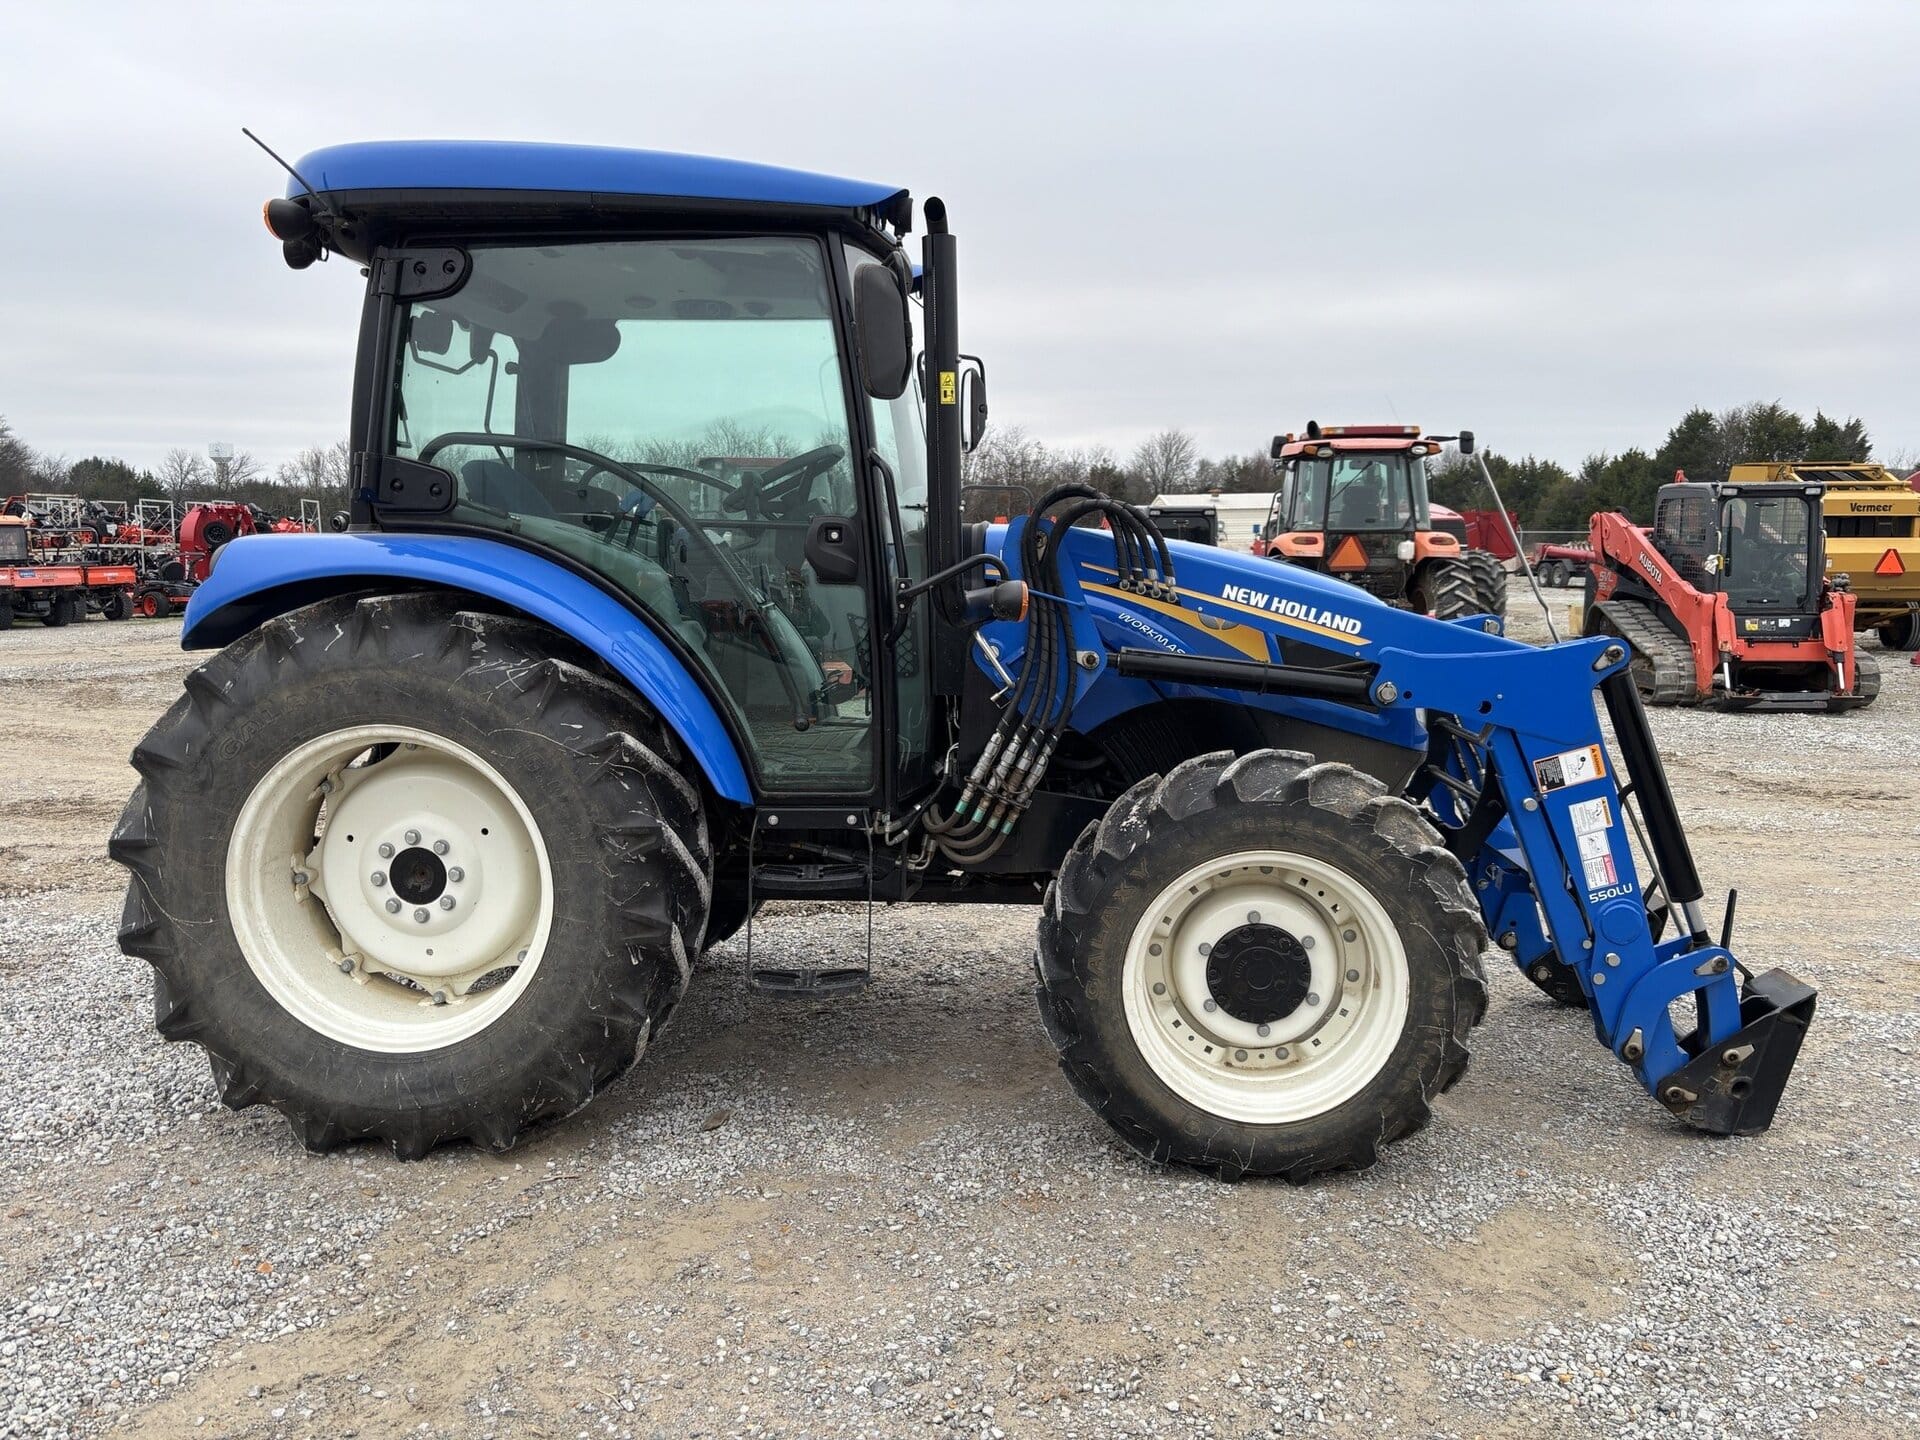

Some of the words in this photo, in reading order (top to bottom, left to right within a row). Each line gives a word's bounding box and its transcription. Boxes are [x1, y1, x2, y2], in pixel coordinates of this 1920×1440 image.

[1850, 503, 1892, 512] Vermeer
[1639, 551, 1662, 585] KUBOTA
[1222, 584, 1269, 609] NEW
[1271, 599, 1362, 635] HOLLAND
[1589, 883, 1633, 904] 550LU
[1085, 857, 1150, 1001] GALAXY
